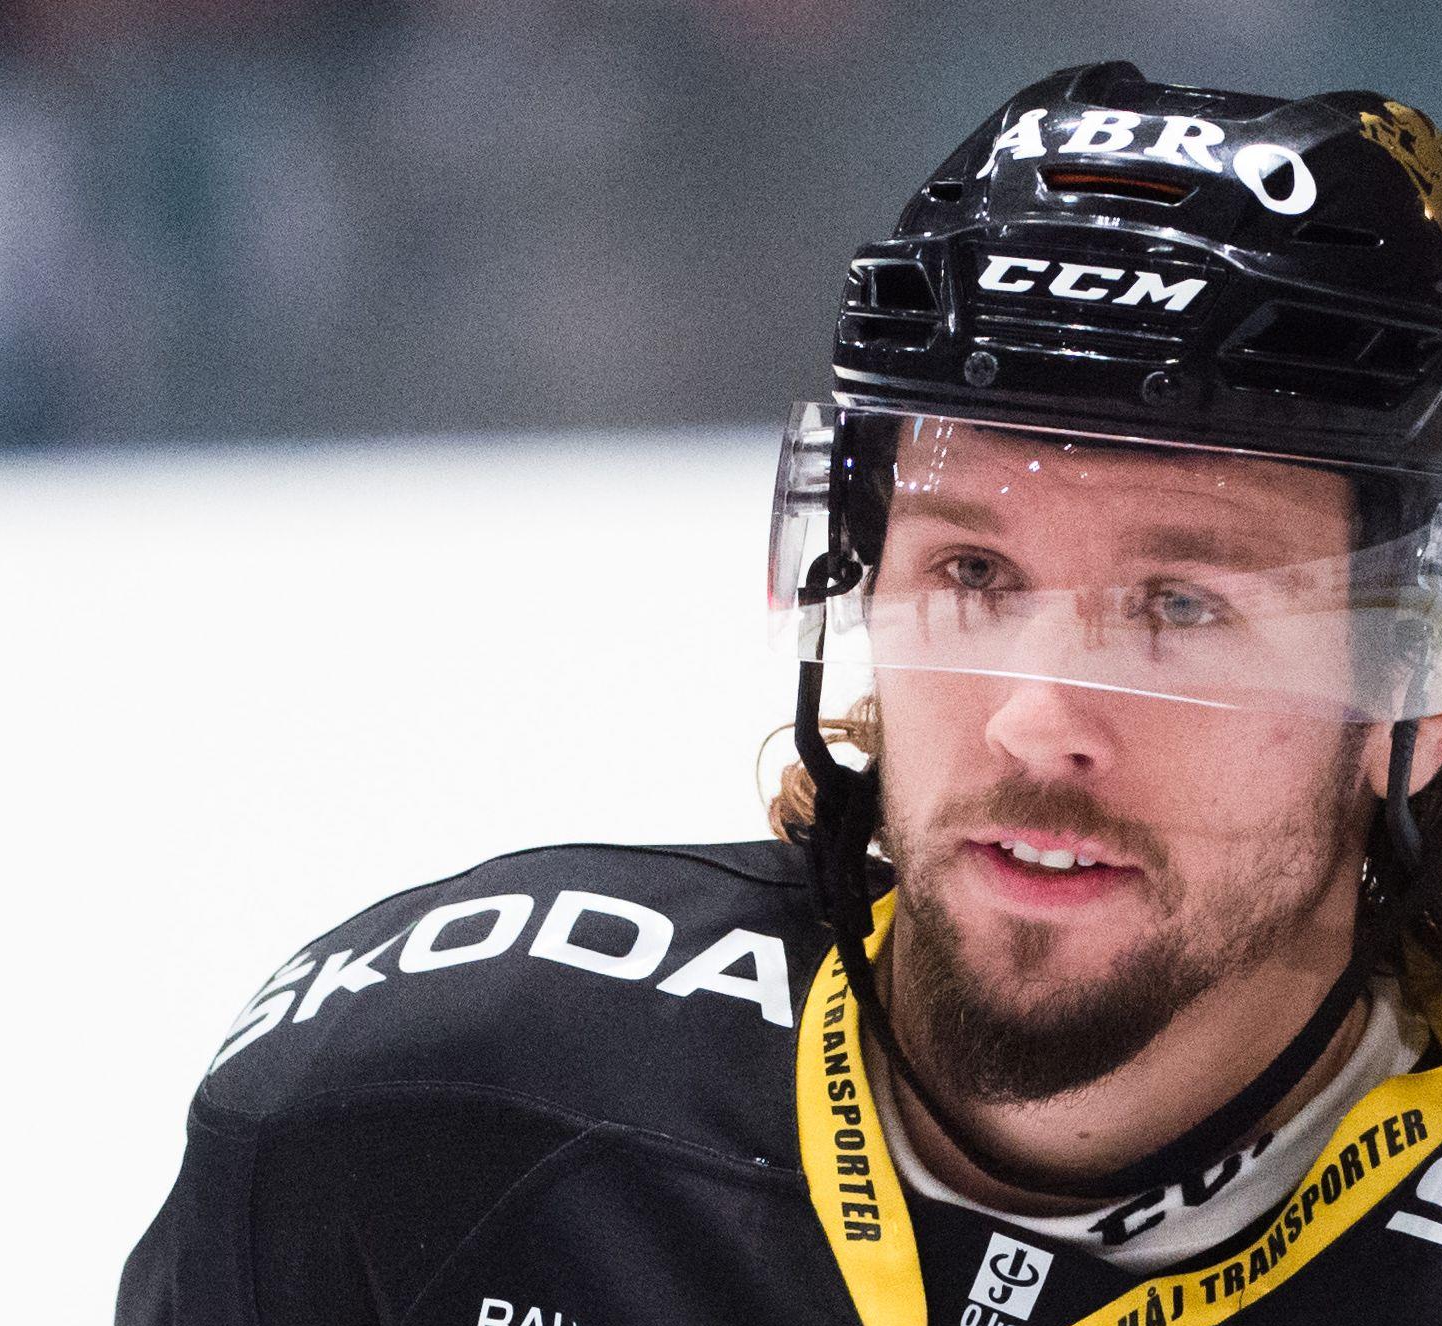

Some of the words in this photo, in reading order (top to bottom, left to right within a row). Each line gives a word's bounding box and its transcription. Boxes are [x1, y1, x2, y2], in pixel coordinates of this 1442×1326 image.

[978, 254, 1207, 312] CCM
[822, 983, 882, 1243] TRANSPORTER
[1200, 1108, 1428, 1305] TRANSPORTER
